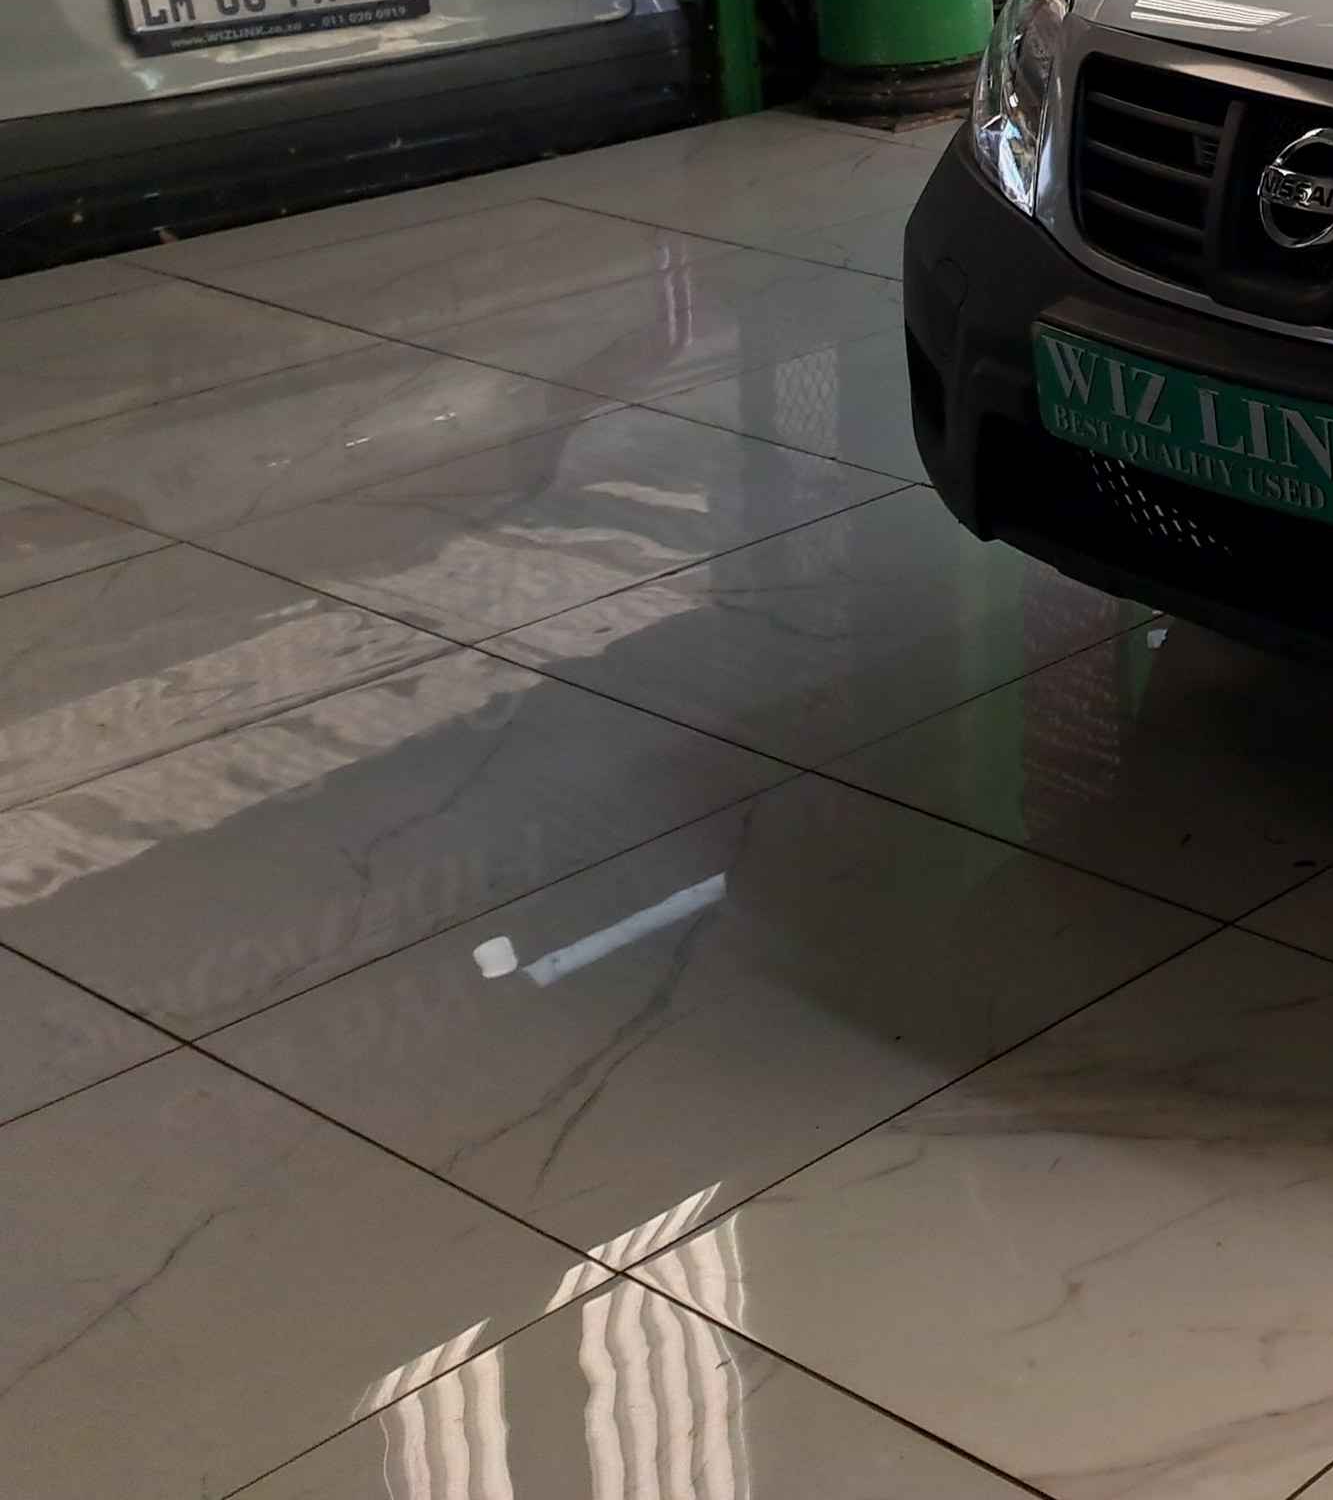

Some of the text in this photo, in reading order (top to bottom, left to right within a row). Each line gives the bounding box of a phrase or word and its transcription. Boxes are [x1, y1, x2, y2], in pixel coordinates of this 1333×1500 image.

[1041, 336, 1172, 433] WIZ
[1054, 405, 1112, 443] BEST
[1121, 432, 1234, 487] QUALITY
[1247, 467, 1325, 510] USED
